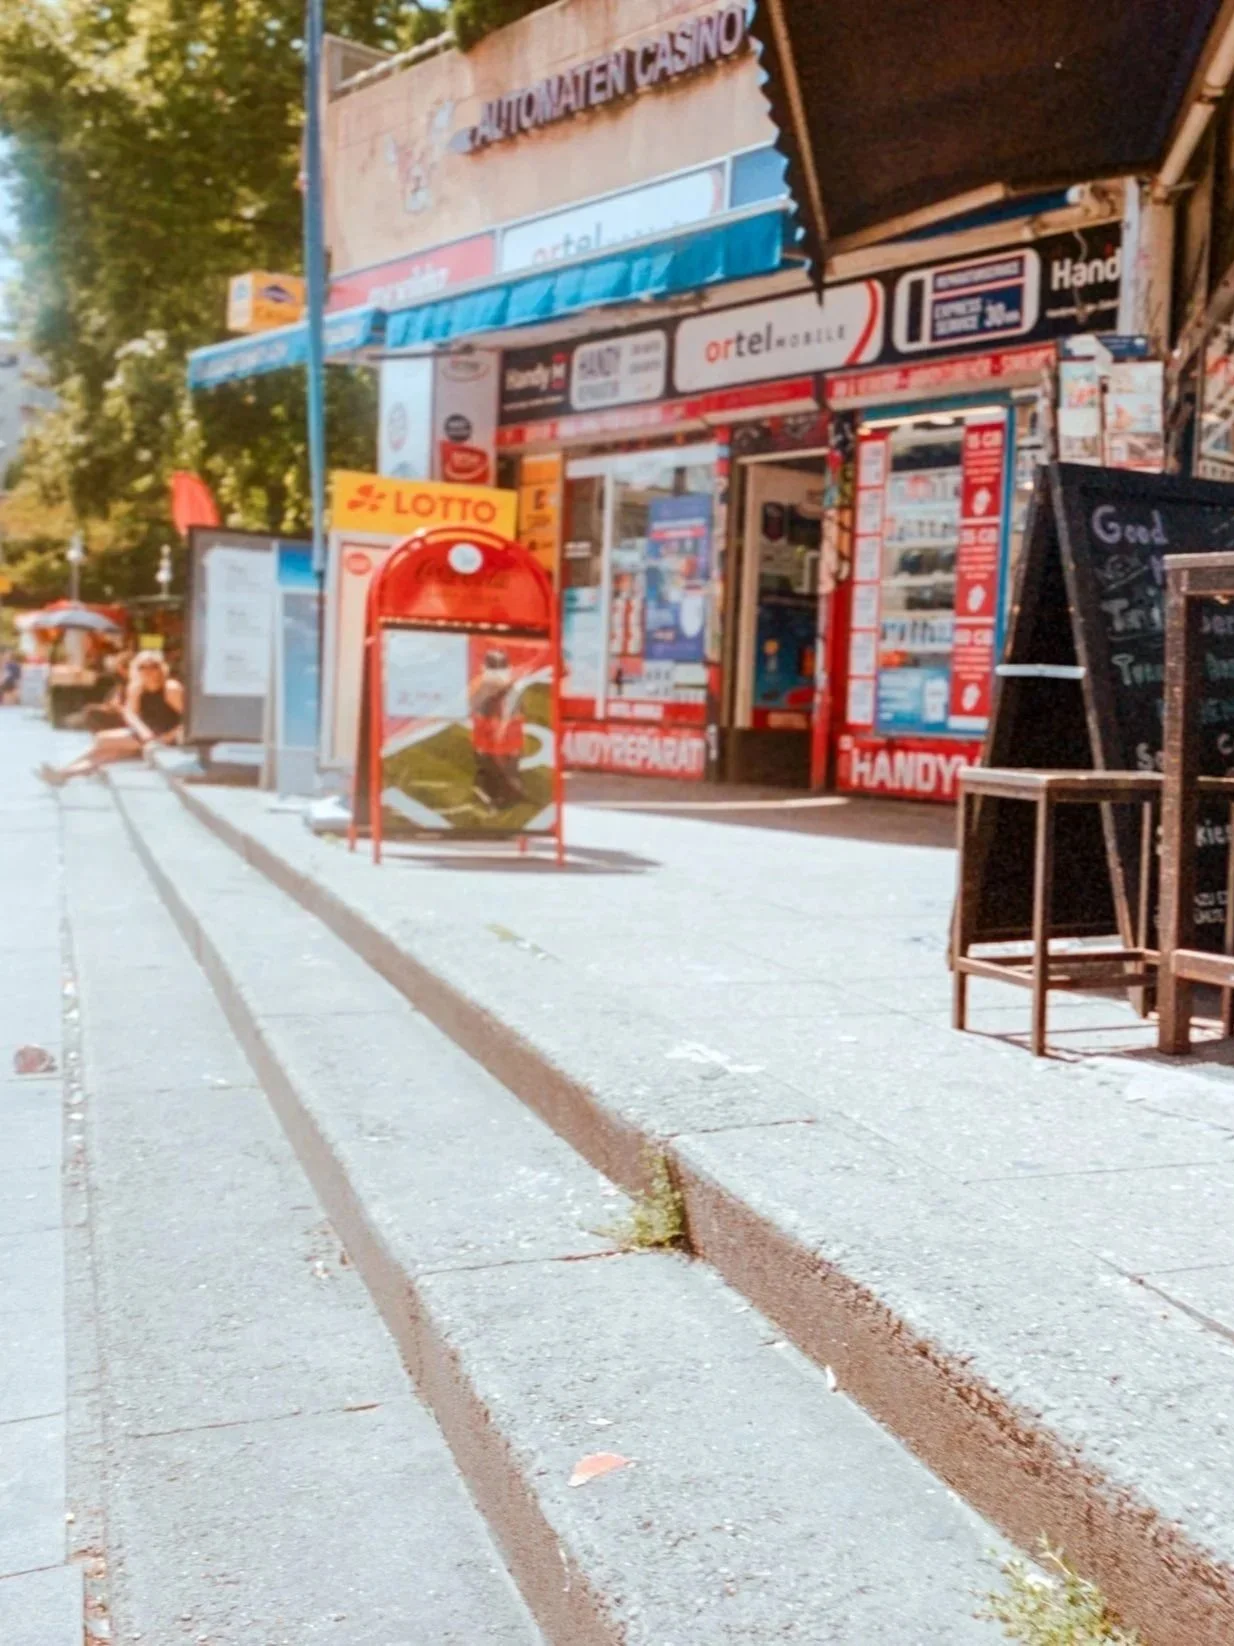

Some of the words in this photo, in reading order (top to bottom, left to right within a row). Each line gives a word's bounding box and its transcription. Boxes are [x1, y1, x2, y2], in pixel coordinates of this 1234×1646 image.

[475, 49, 628, 146] AUTOMATEN
[633, 4, 746, 86] CASINO
[705, 321, 773, 364] ortel
[775, 324, 848, 349] MOBILE
[394, 489, 497, 524] LOTTO
[1092, 504, 1169, 545] Good
[851, 747, 968, 795] HANDY
